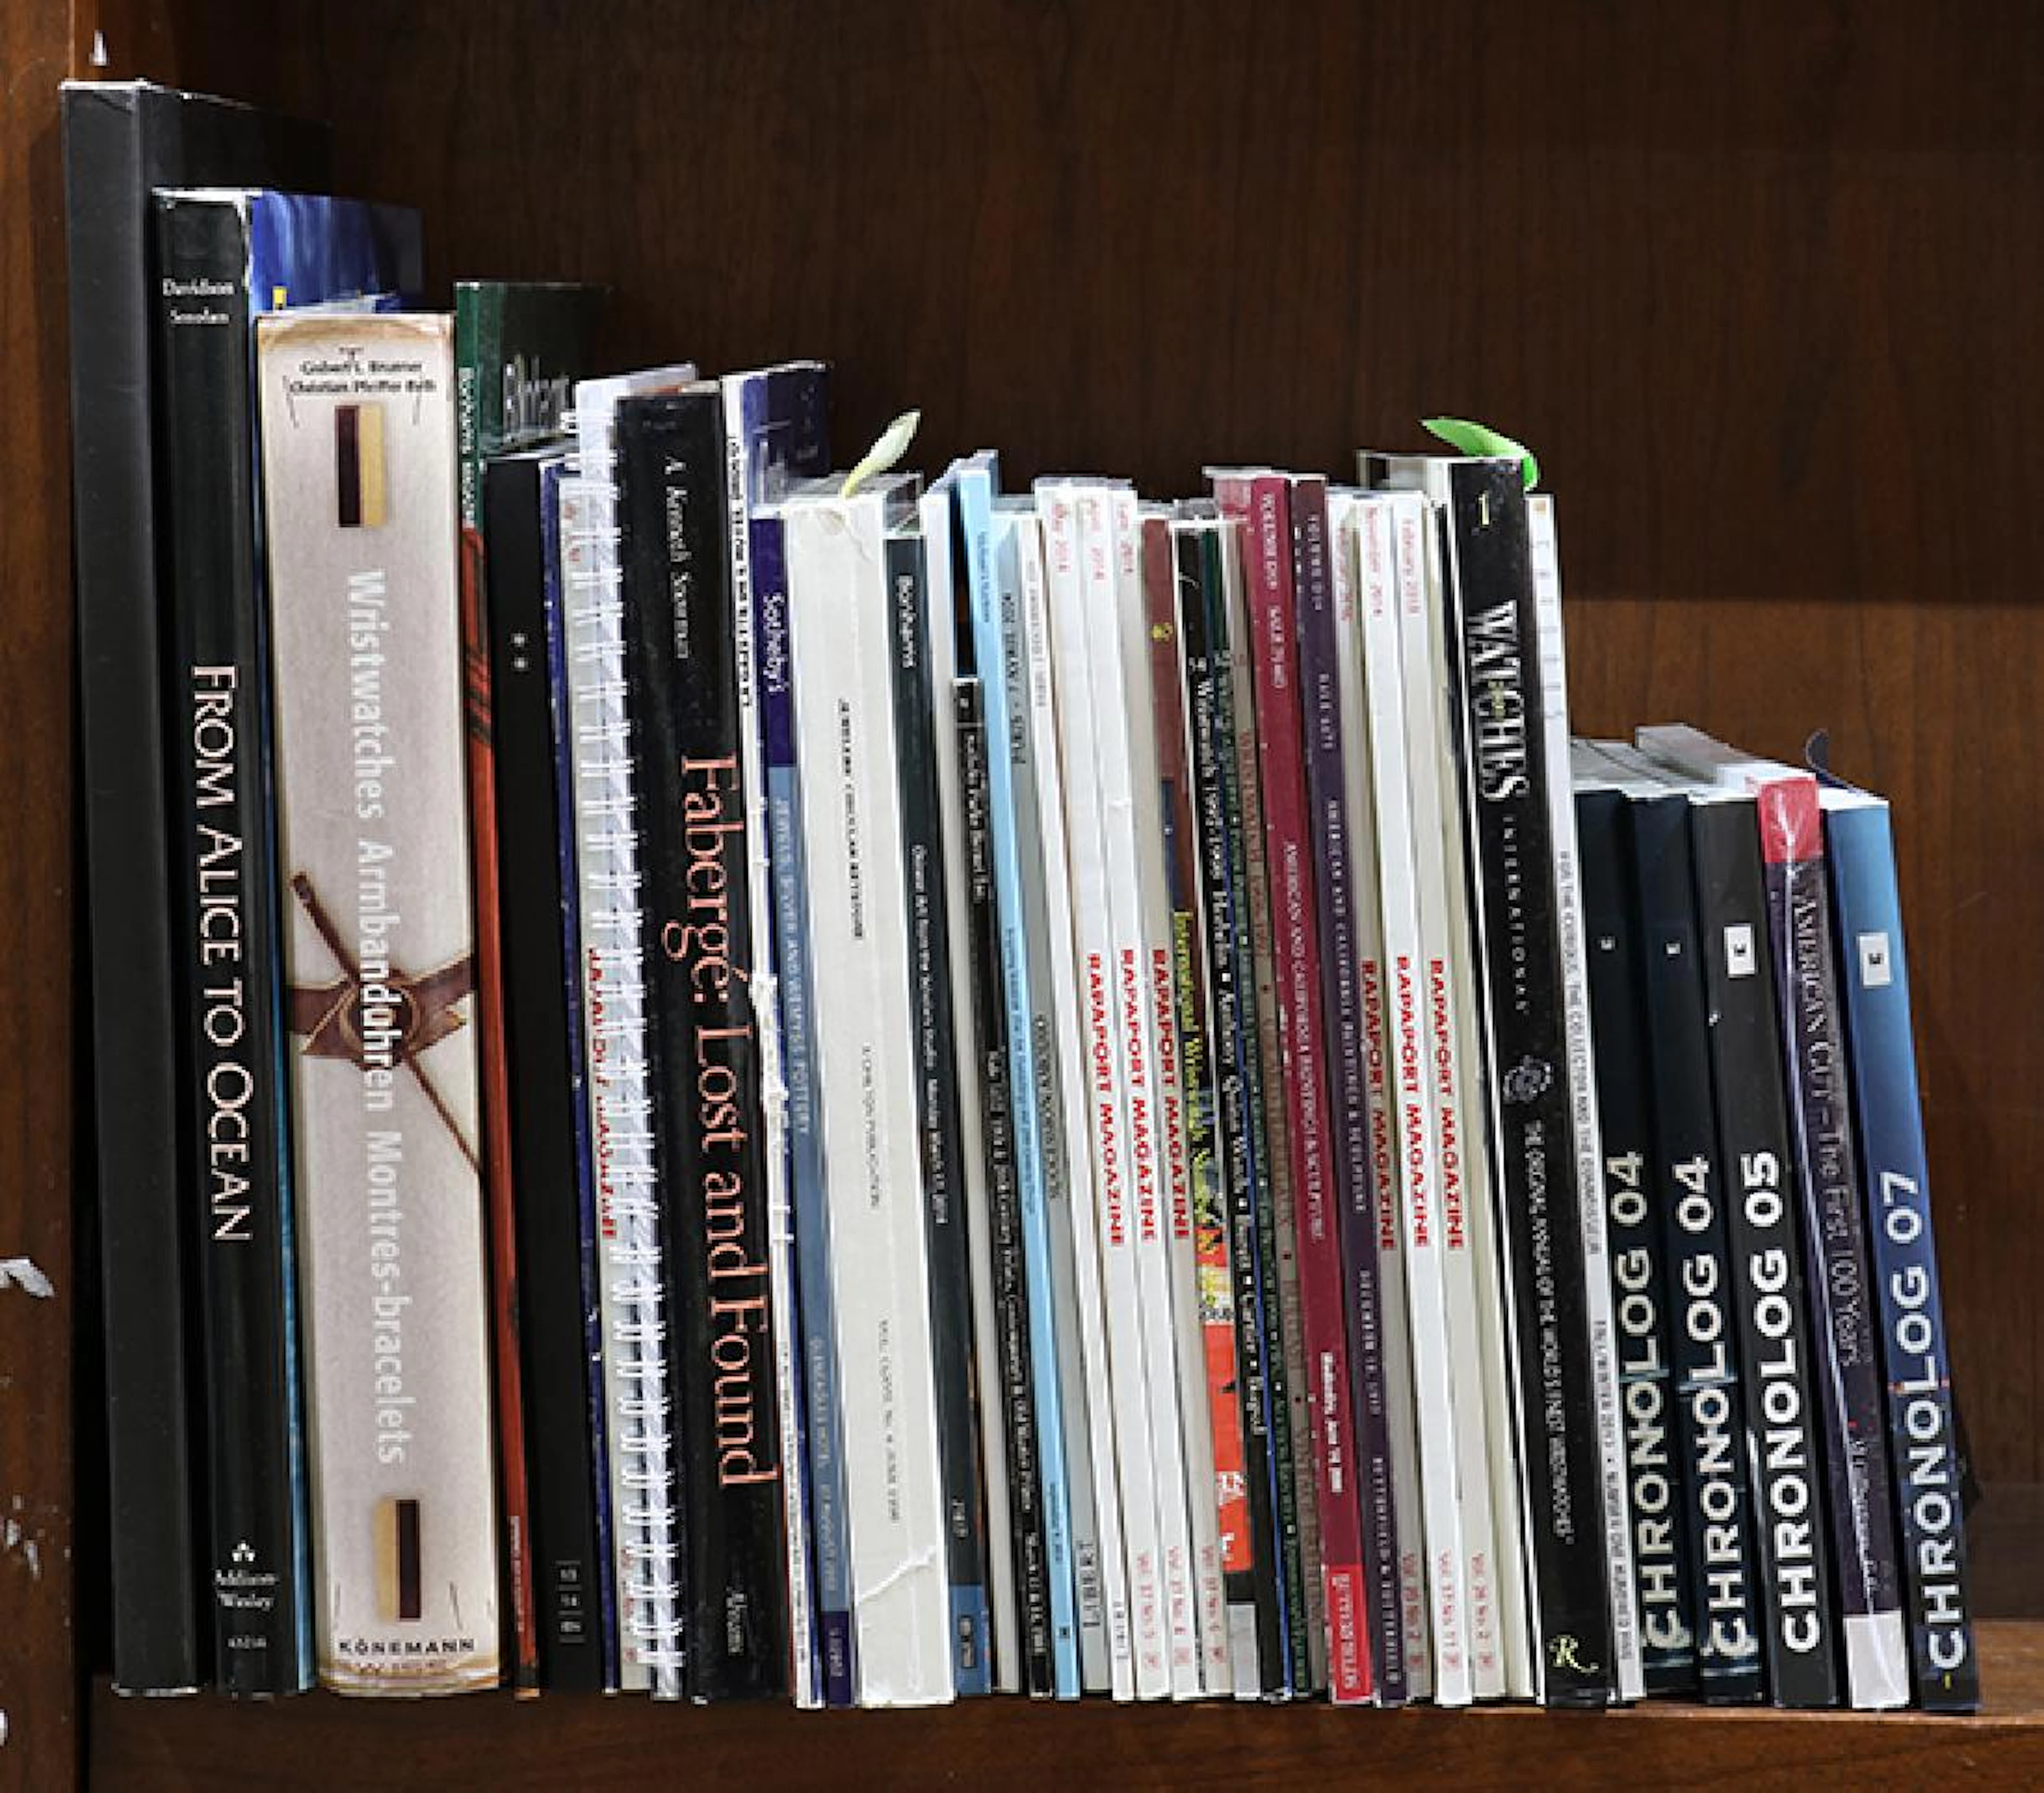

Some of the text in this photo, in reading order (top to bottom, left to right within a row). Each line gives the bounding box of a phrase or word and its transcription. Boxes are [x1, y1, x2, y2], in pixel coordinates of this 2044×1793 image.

[763, 592, 787, 695] Sotheby's
[896, 575, 916, 668] Bonhams
[1465, 600, 1529, 802] WATCHES
[190, 664, 254, 1241] FROM ALICE TO OCEAN
[348, 569, 415, 1464] Wristwatches Armbanduhren Montres-bracelets
[779, 876, 797, 936] SILVER
[783, 941, 800, 975] AND
[661, 754, 781, 1486] Fabergé: Lost and Found
[790, 1059, 810, 1135] POTTERY
[1087, 953, 1124, 1247] RAPAPORT MAGAZINE
[1121, 949, 1155, 1243] RAPAPORT MAGAZINE
[1152, 949, 1188, 1240] RAPAPORT MAGAZINE
[1361, 960, 1395, 1251] RAPAPORT MAGAZINE
[1396, 957, 1429, 1247] RAPAPORT MAGAZINE
[1430, 959, 1463, 1249] RAPAPORT MAGAZINE
[1605, 1151, 1686, 1649] CHRONOLOG 04
[1671, 1155, 1753, 1656] CHRONOLOG 04
[1739, 1151, 1819, 1653] CHRONOLOG 05
[1880, 1171, 1966, 1670] CHRONOLOG 07
[339, 1639, 474, 1656] KÖNEMANN
